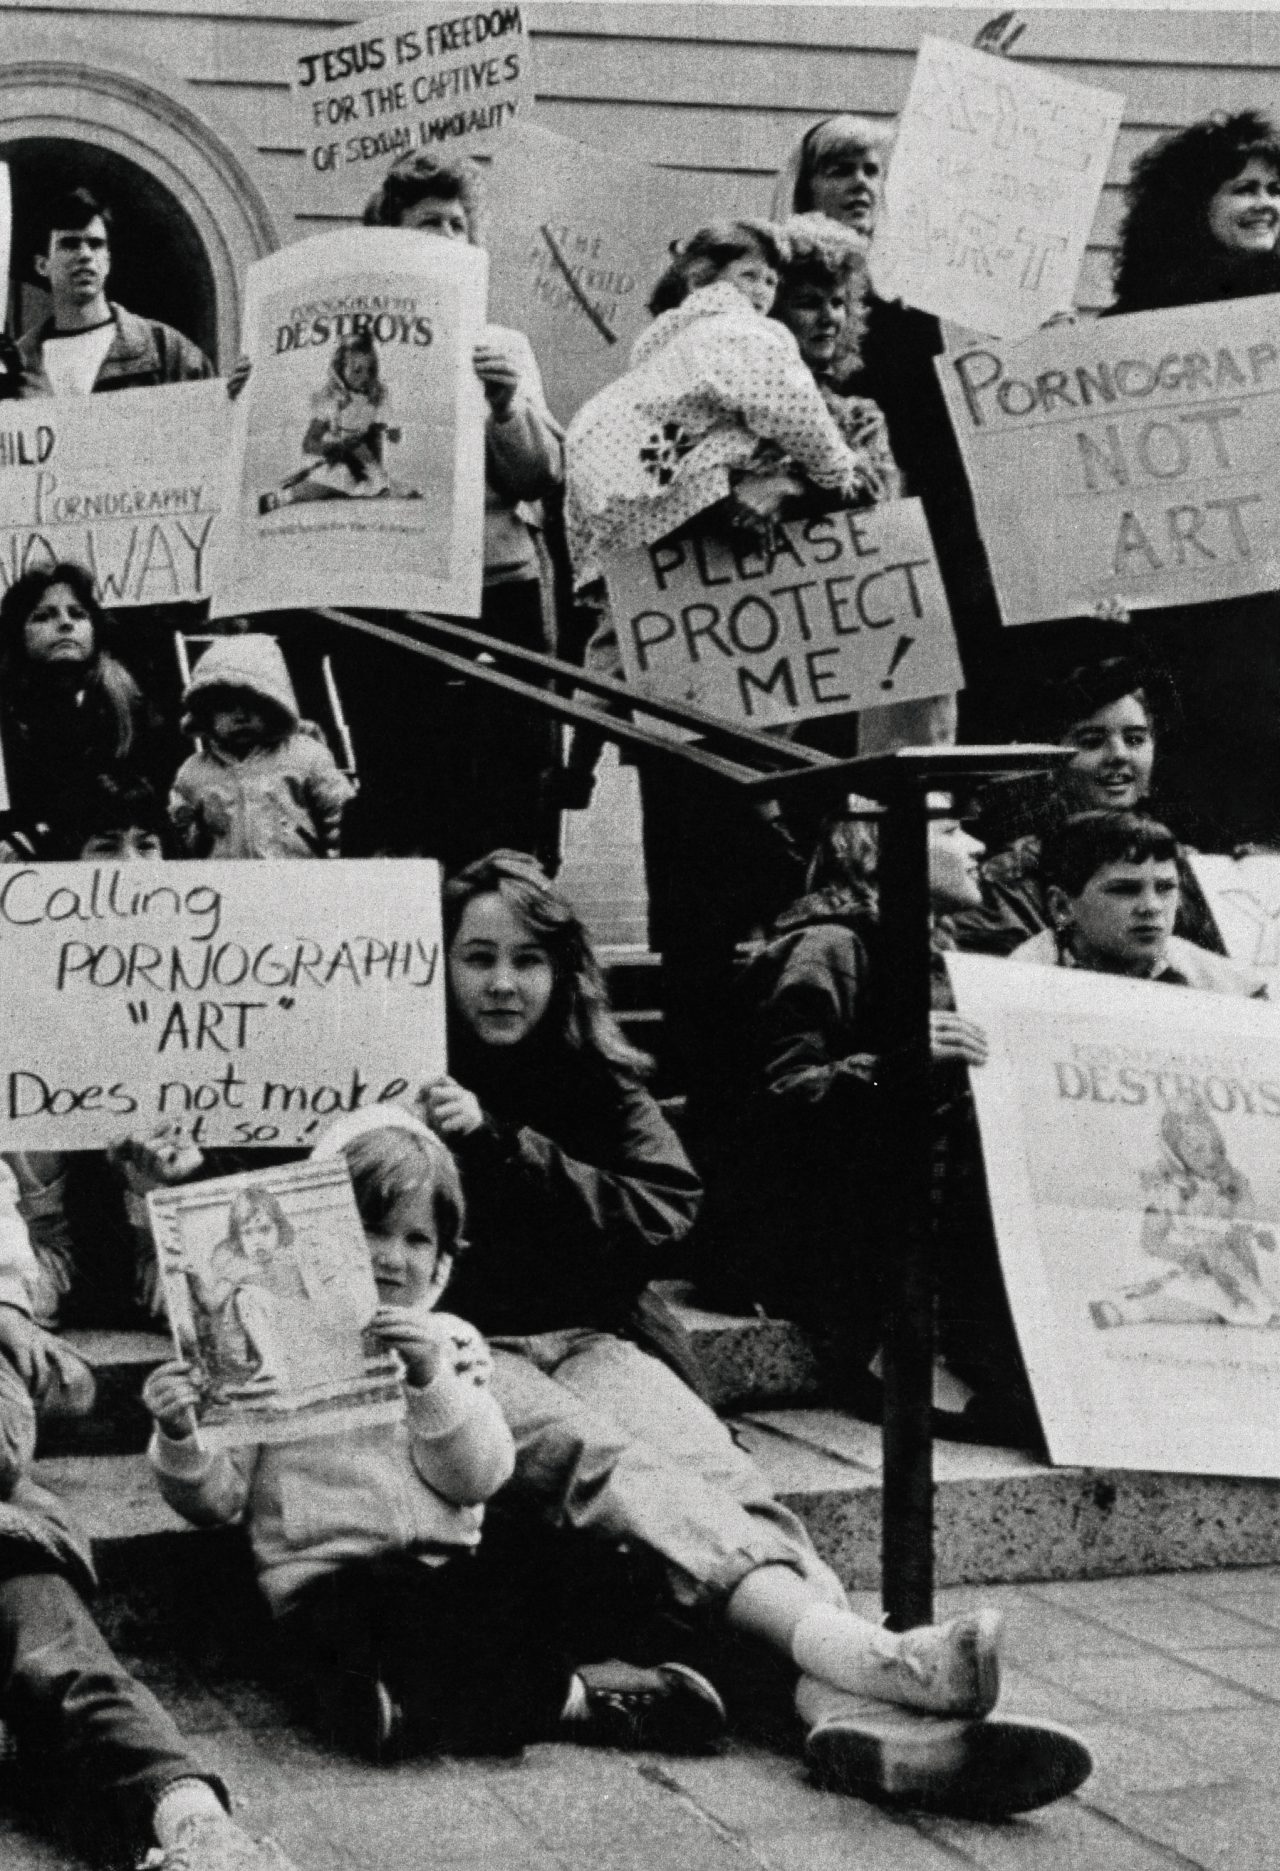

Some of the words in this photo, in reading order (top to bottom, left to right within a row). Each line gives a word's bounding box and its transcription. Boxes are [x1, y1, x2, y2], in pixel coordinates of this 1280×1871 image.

[297, 38, 385, 87] JESUS
[395, 31, 422, 64] IS
[426, 6, 521, 57] FREEDOM
[312, 95, 358, 127] FOR
[361, 81, 406, 117] THE
[413, 53, 519, 104] CAPTIVES
[313, 142, 340, 171] OF
[275, 311, 435, 356] DESTROYS
[1077, 407, 1241, 490] NOT
[35, 471, 203, 525] PORNOGRAPHY
[1113, 494, 1262, 574] ART
[86, 515, 214, 602] WAY
[647, 508, 881, 590] PLEASE
[630, 558, 931, 671] PROTECT
[55, 934, 440, 992] PORNOGRAPHY
[7, 1070, 137, 1120] Does
[157, 1063, 249, 1112] not
[263, 1067, 410, 1114] make
[1053, 1061, 1280, 1118] DESTROYS
